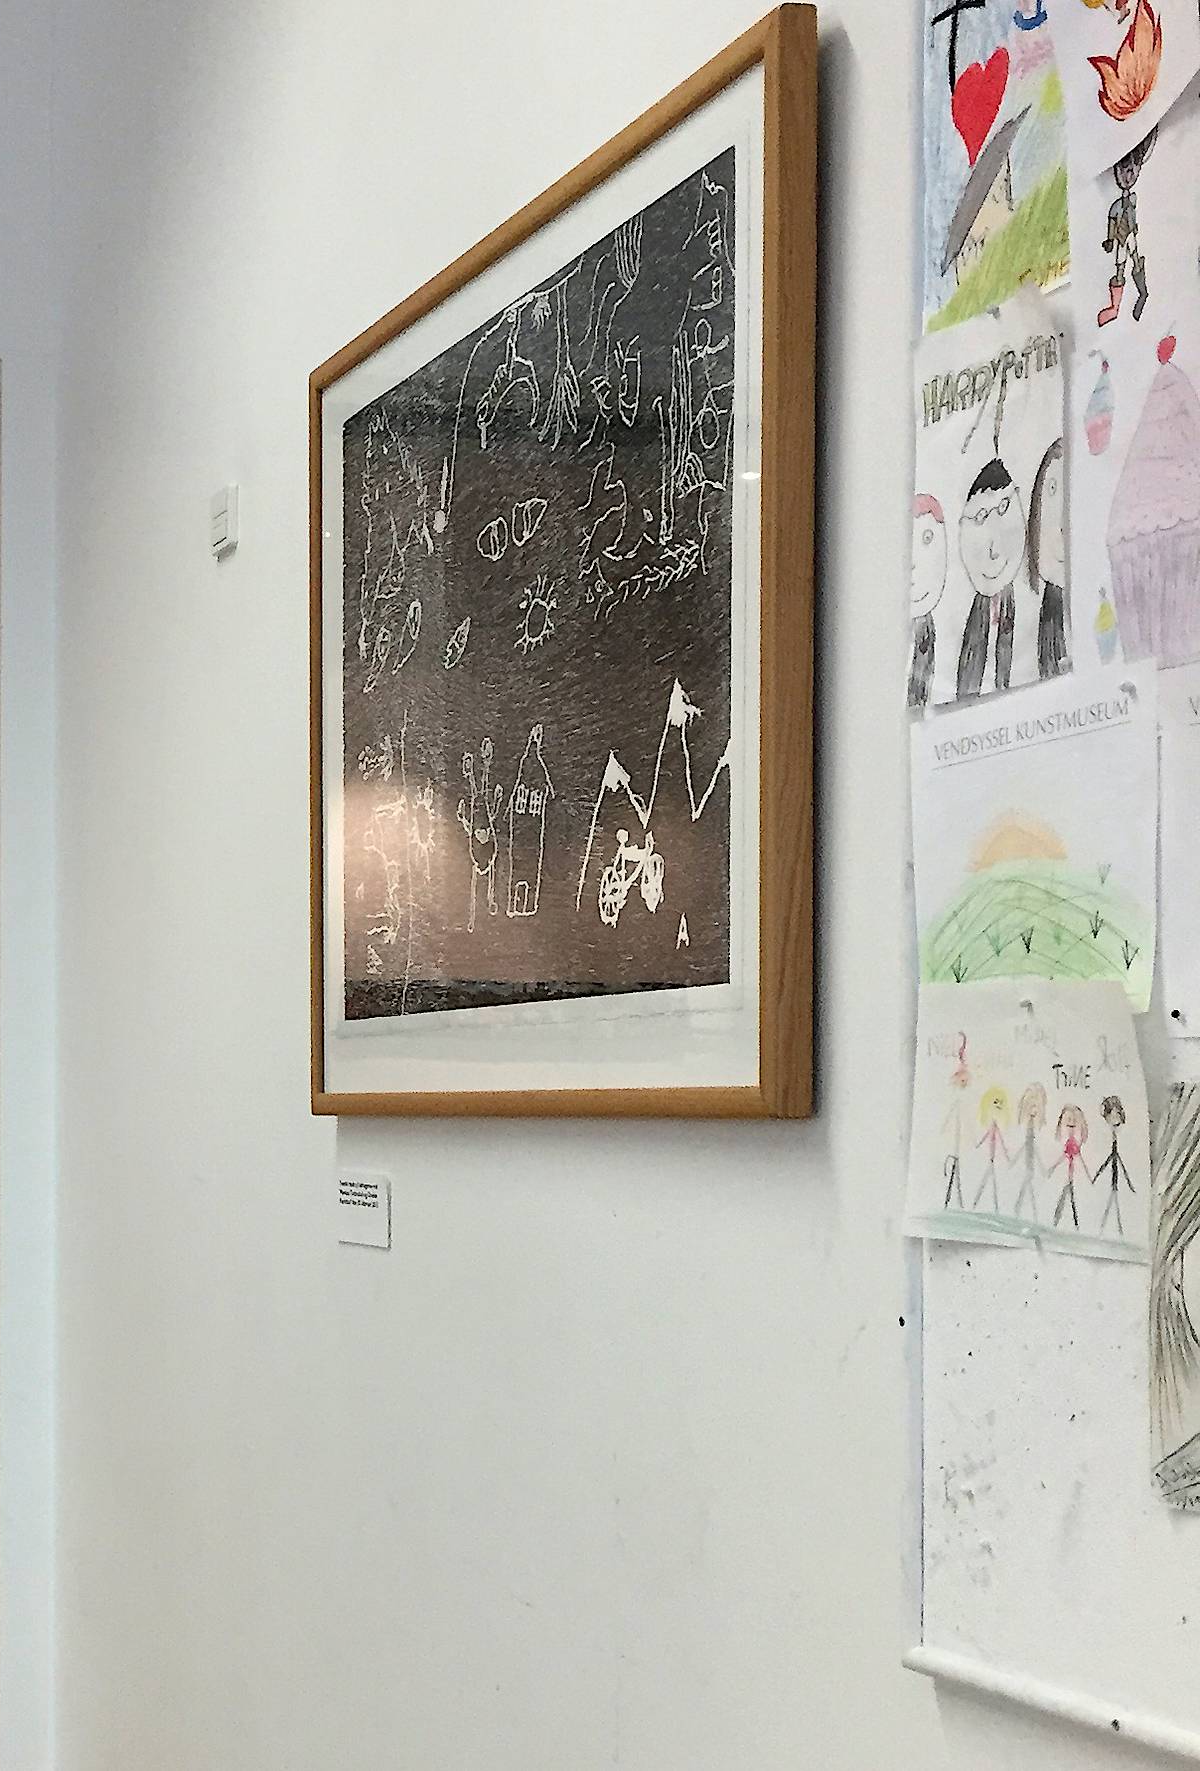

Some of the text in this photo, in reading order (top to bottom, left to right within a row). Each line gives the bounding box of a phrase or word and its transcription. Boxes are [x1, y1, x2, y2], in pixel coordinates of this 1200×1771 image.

[922, 358, 1000, 428] HARRY
[933, 699, 1129, 761] VENDSYSSEL KUNSTMUSEUM
